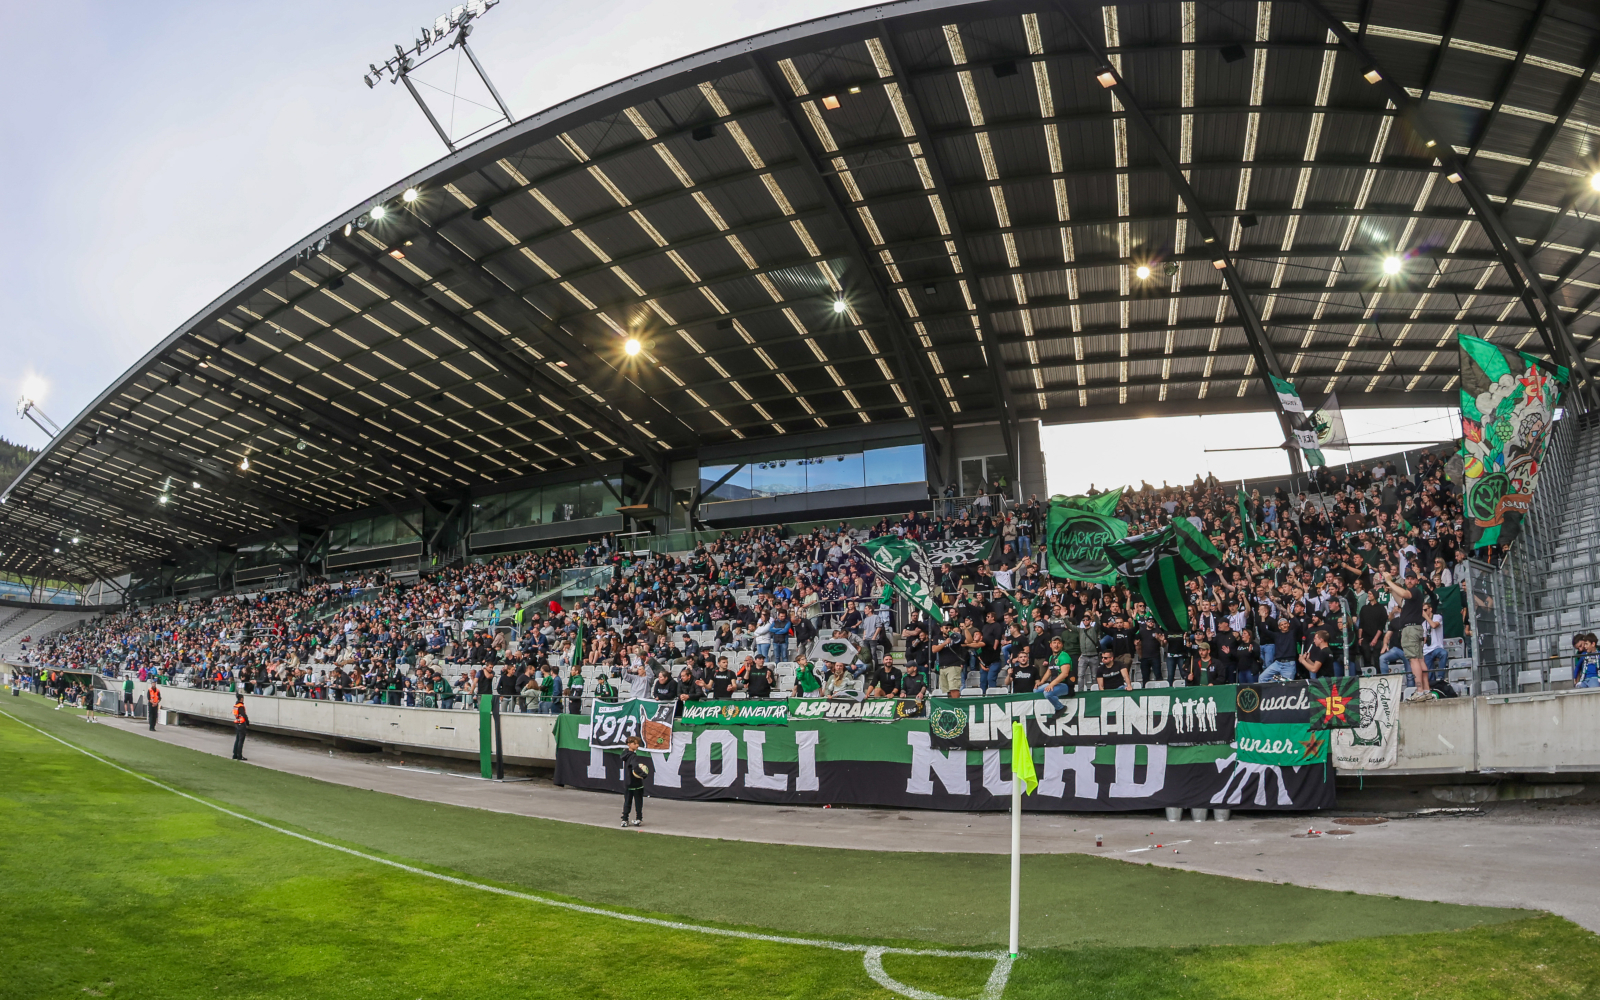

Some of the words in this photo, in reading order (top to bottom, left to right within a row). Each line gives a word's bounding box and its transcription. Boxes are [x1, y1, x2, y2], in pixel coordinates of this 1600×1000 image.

[1061, 530, 1110, 547] WACKER
[1057, 547, 1110, 563] INVENTA
[1260, 688, 1310, 711] wack
[1325, 696, 1346, 716] 15
[682, 705, 722, 719] WACKER
[738, 704, 788, 719] INVENTAR
[794, 701, 894, 718] ASPIRANTE
[969, 696, 1170, 741] UNTERLAND
[593, 714, 637, 743] 1913
[1239, 737, 1299, 754] unser.
[578, 724, 819, 792] TVOLI
